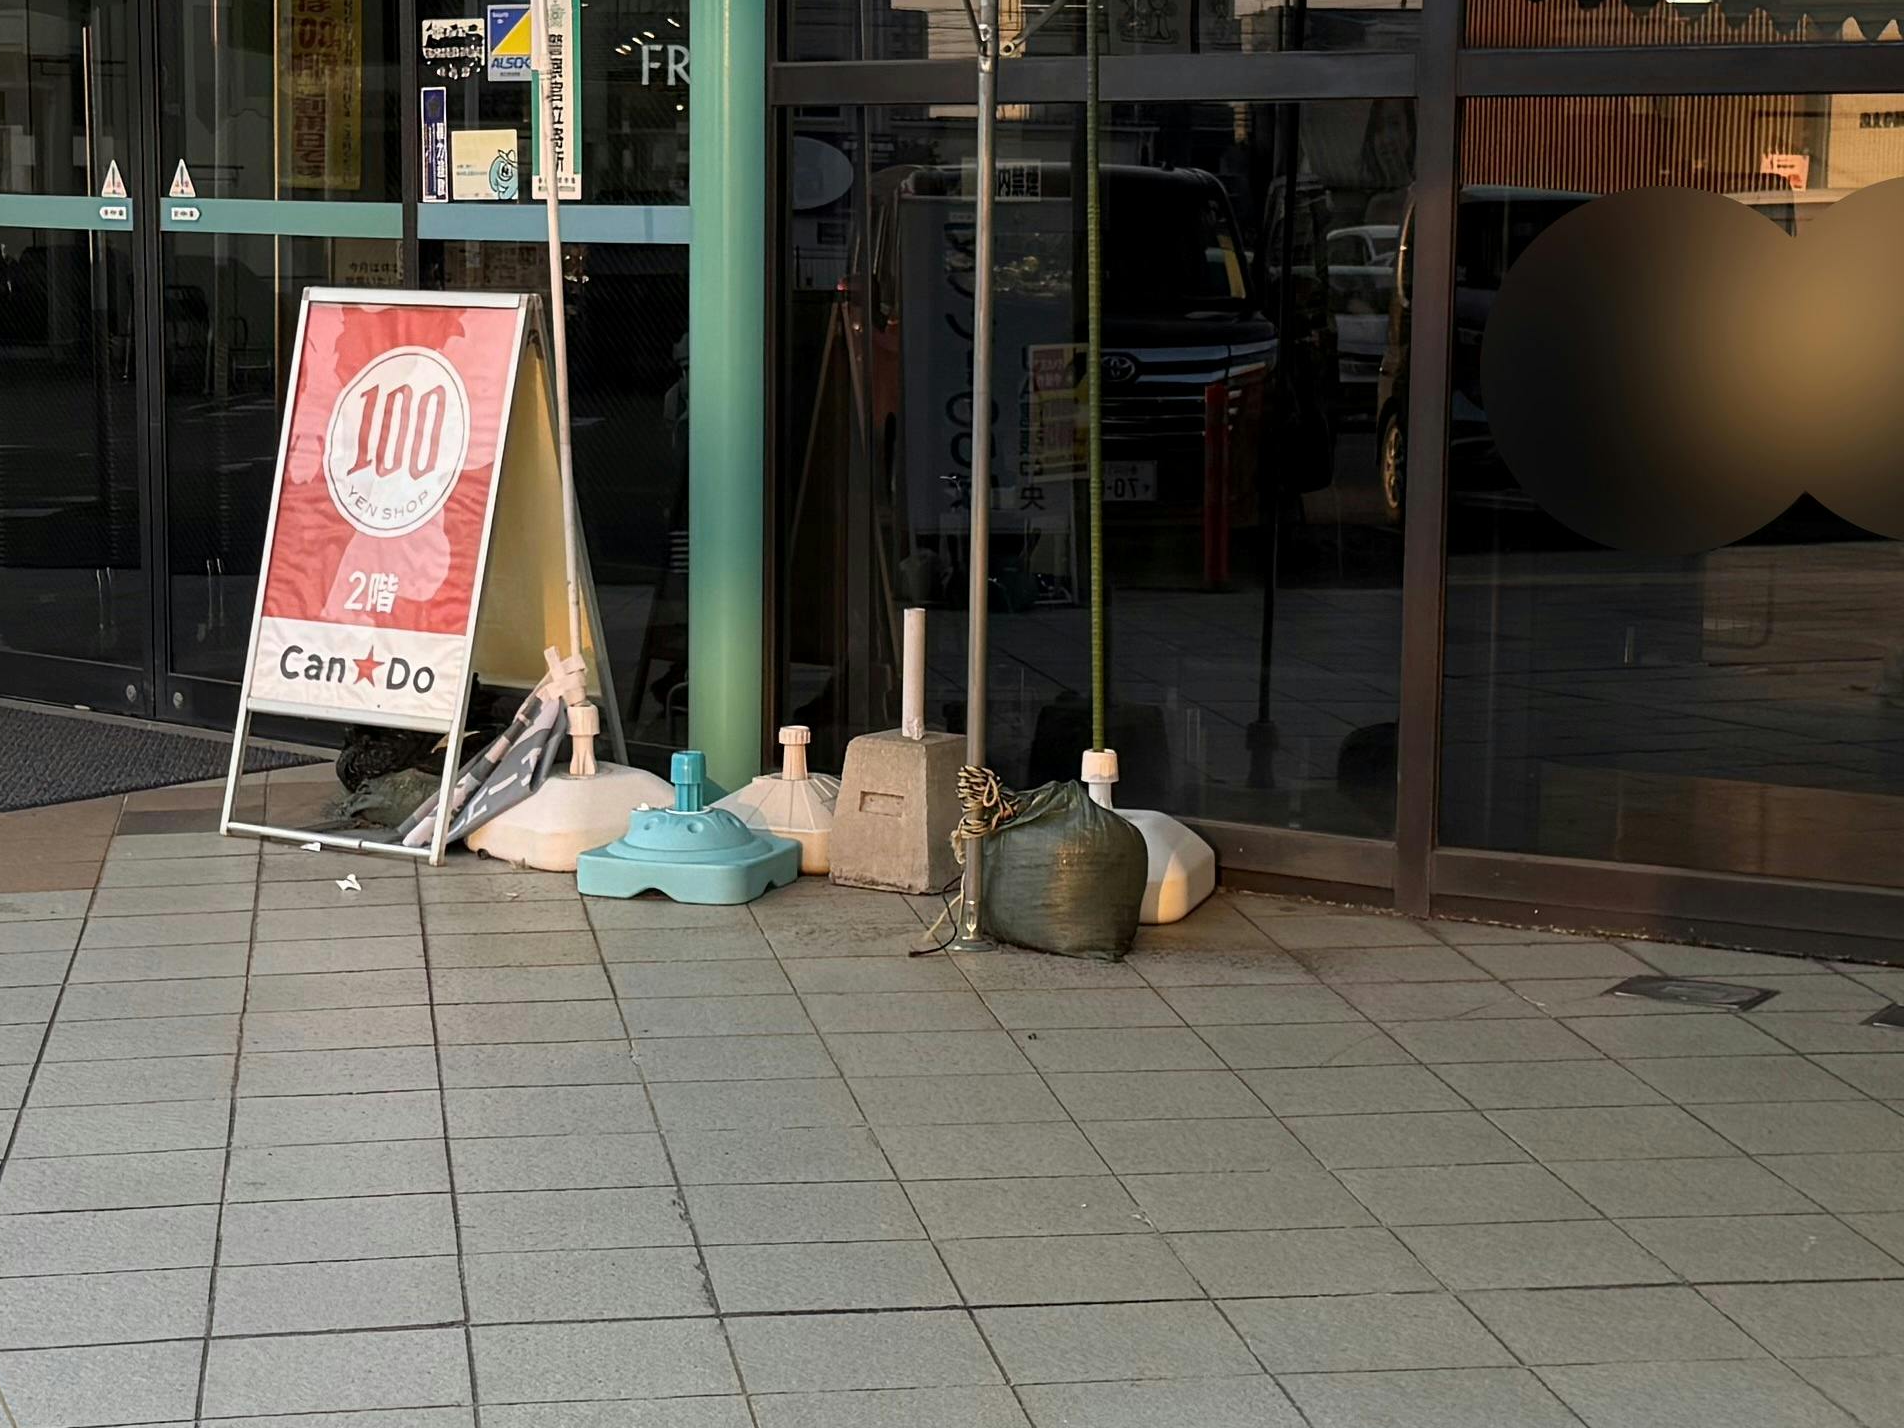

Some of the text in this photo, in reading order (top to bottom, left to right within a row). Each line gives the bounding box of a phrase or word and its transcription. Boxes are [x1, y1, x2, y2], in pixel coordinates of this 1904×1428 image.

[346, 383, 447, 481] 100
[348, 486, 431, 521] YEN SHOP
[343, 571, 400, 614] 2階
[279, 645, 436, 694] Can Do
